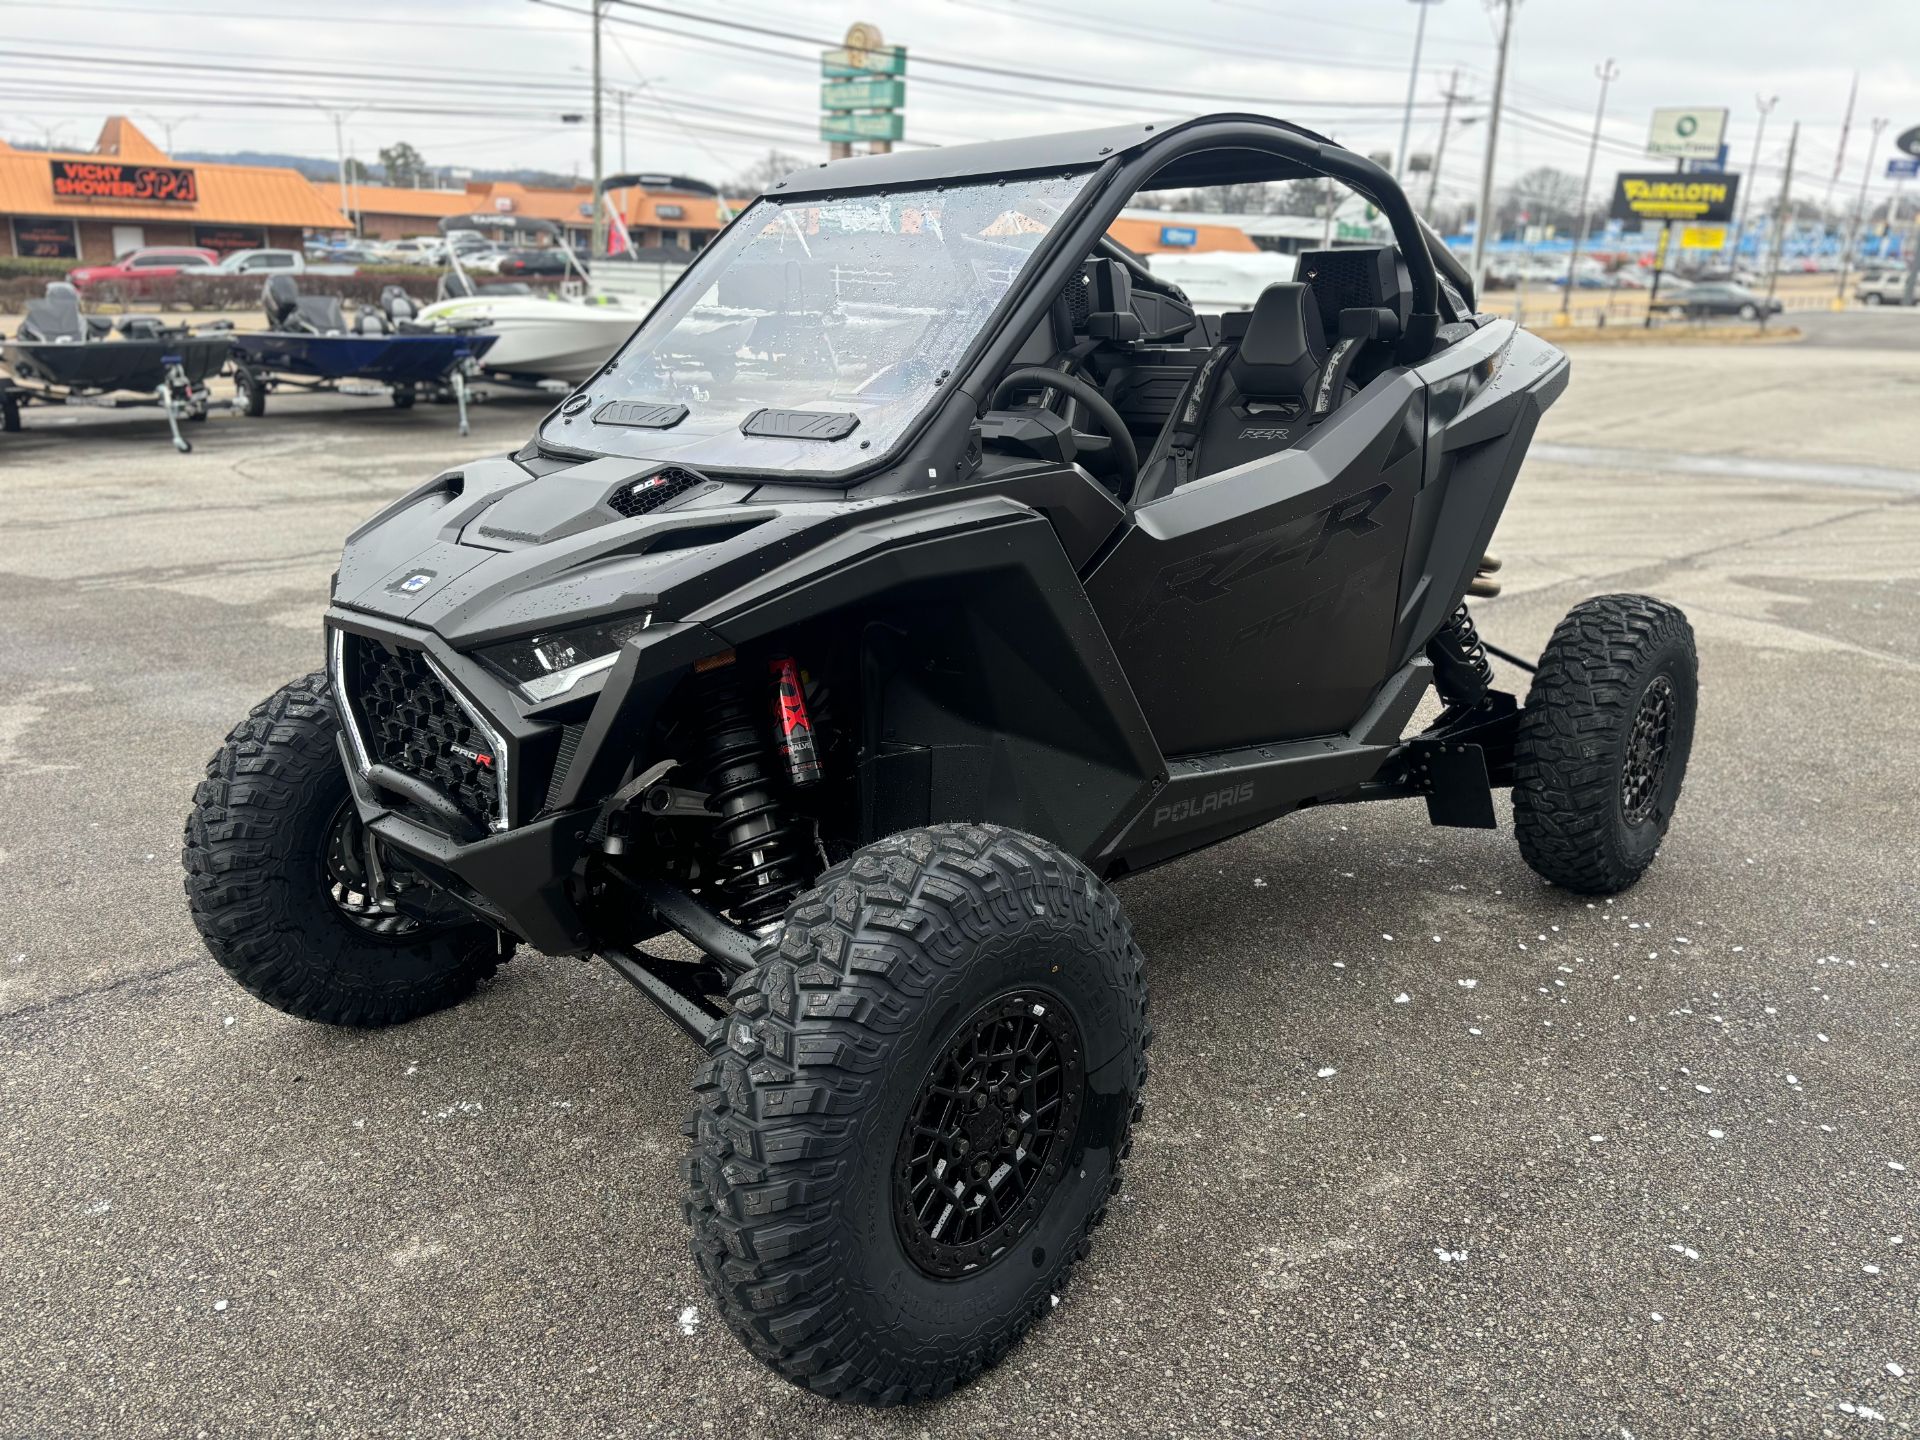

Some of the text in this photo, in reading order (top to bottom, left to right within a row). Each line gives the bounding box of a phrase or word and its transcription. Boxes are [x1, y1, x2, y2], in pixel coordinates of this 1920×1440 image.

[63, 163, 122, 180] VICHY
[135, 167, 196, 200] SPA
[55, 177, 137, 197] SHOWER
[1238, 428, 1290, 440] RZR
[1119, 482, 1393, 641] RZR
[1153, 782, 1255, 827] POLARIS
